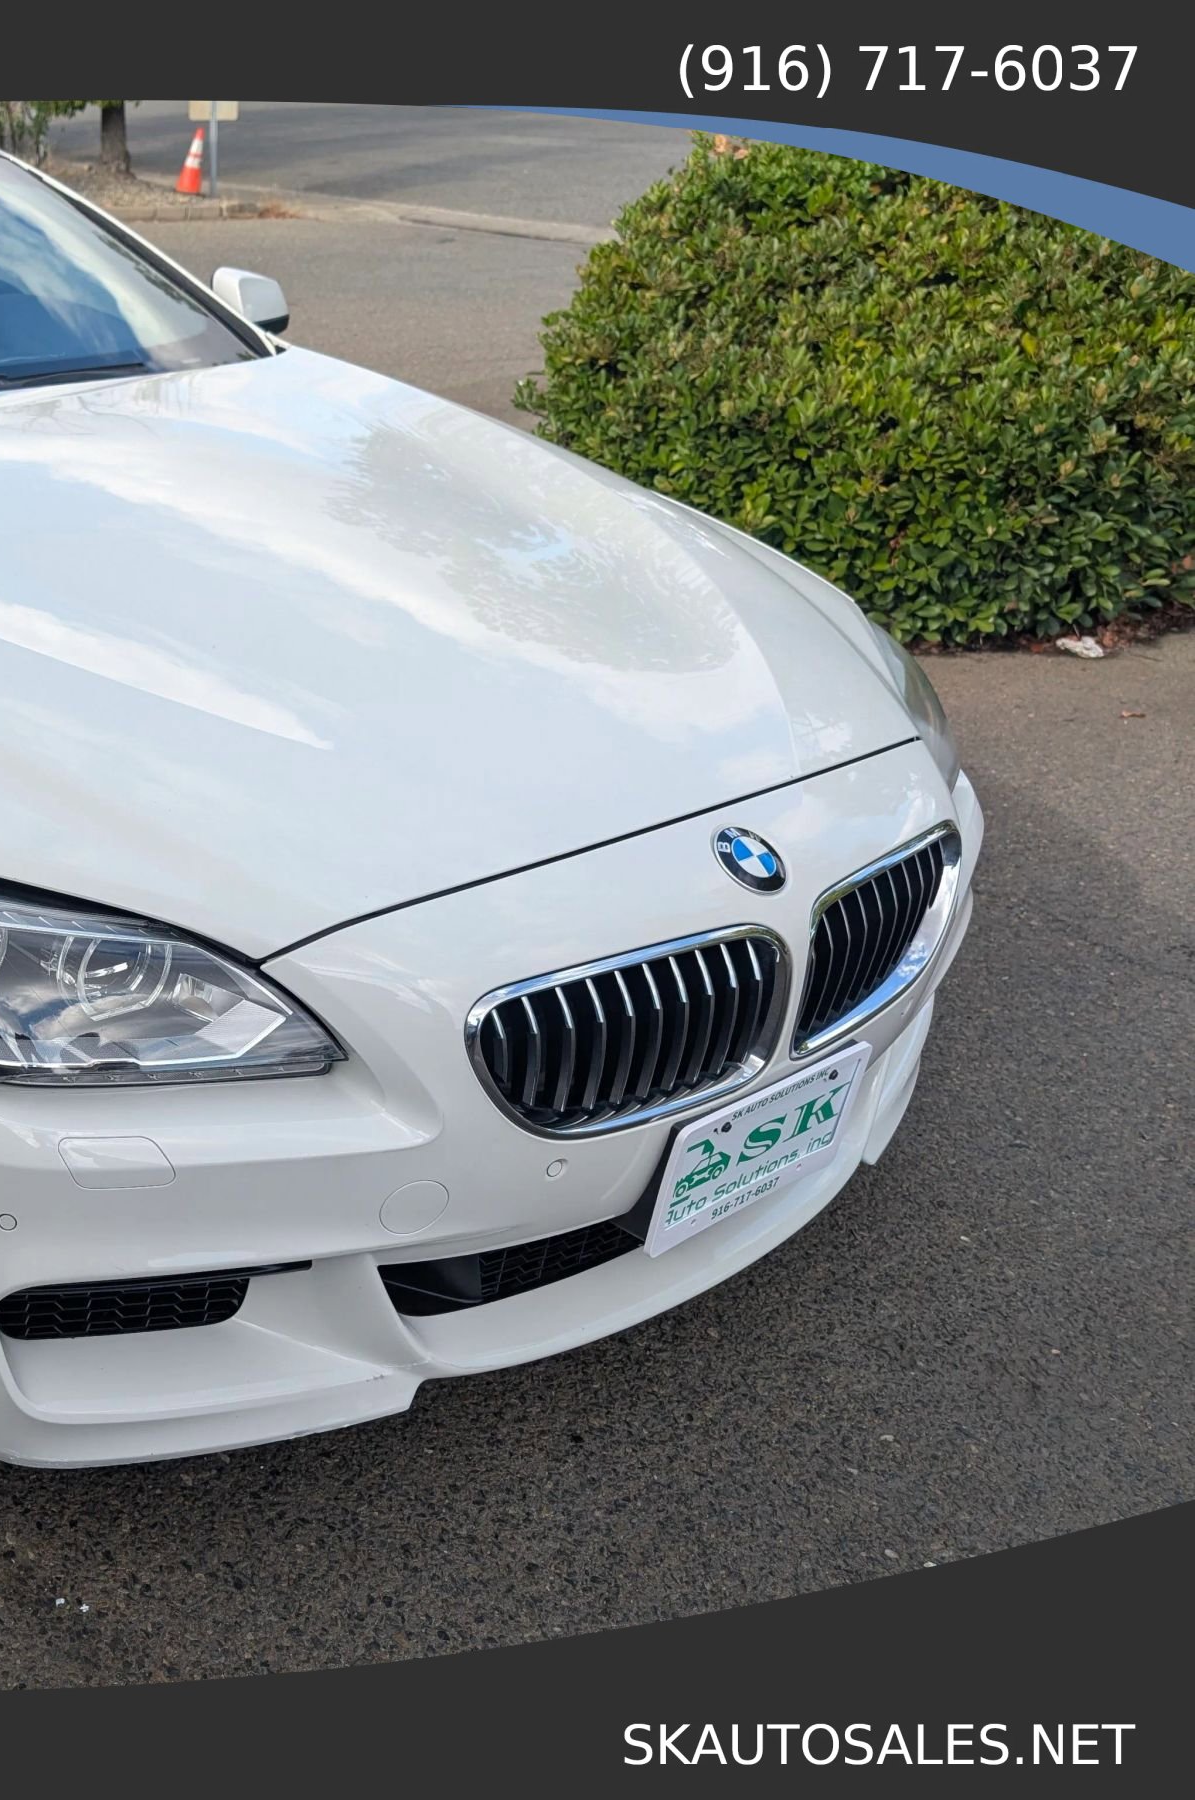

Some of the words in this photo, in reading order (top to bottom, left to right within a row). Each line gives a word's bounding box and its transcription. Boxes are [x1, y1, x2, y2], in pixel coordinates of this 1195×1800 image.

[731, 1110, 745, 1121] SK
[744, 1099, 769, 1115] AUTO
[769, 1075, 816, 1104] SOLUTIONS
[814, 1067, 830, 1081] INC
[735, 1082, 851, 1167] SK
[710, 1176, 781, 1220] 916-717-6037
